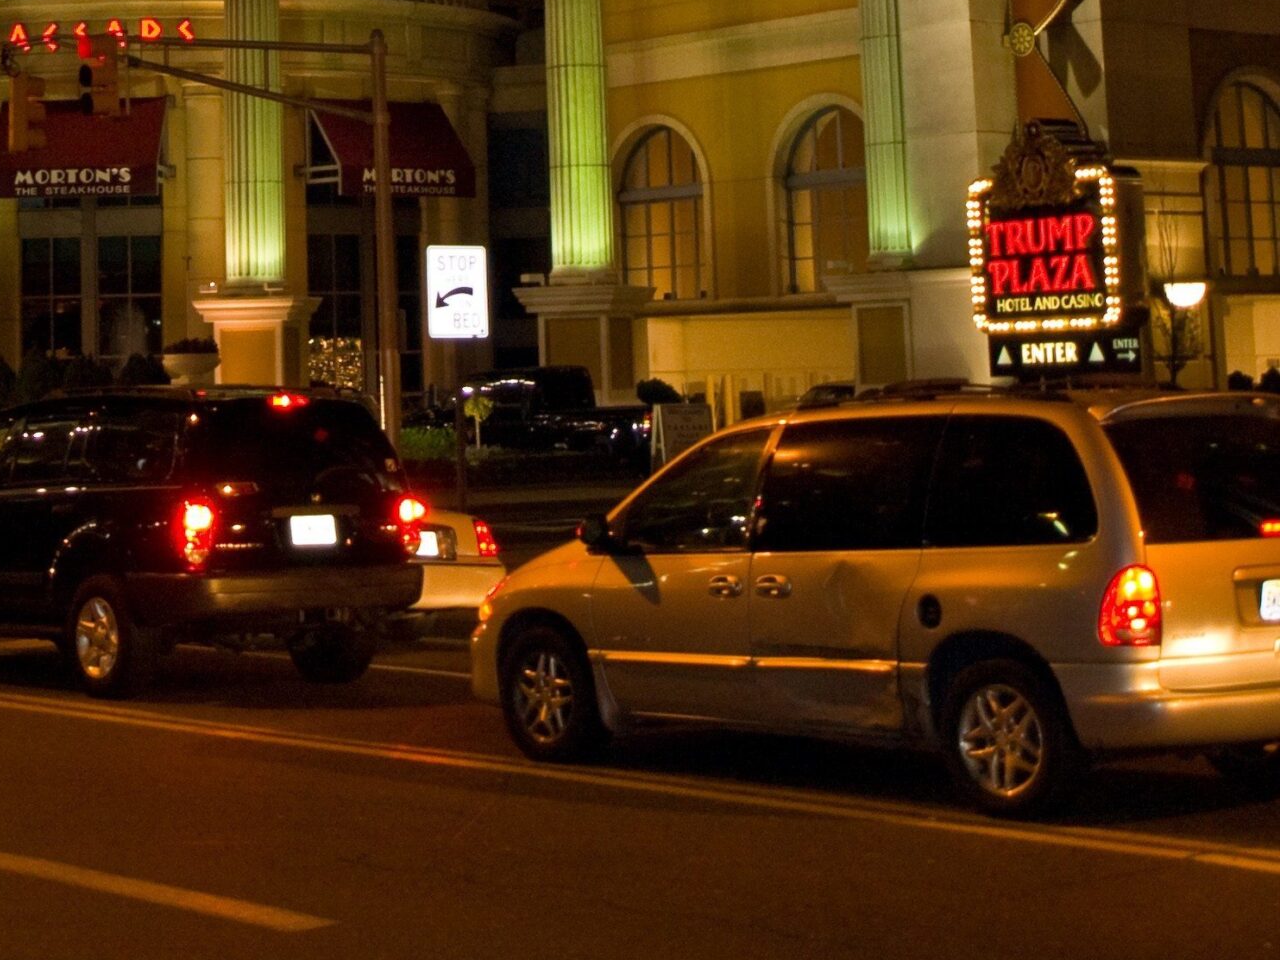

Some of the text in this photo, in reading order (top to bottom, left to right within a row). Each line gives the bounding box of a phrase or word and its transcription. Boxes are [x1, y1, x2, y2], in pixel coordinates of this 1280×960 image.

[14, 167, 132, 185] MORTON'S
[362, 167, 457, 184] MRTON'S
[15, 185, 131, 196] THE STEAKHOUSE
[985, 214, 1095, 256] TRUMP
[437, 255, 477, 272] STOP
[987, 254, 1096, 295] PLAZA
[996, 292, 1104, 313] HOTEL AND CASINO
[1021, 338, 1139, 364] ENTER ENTER
